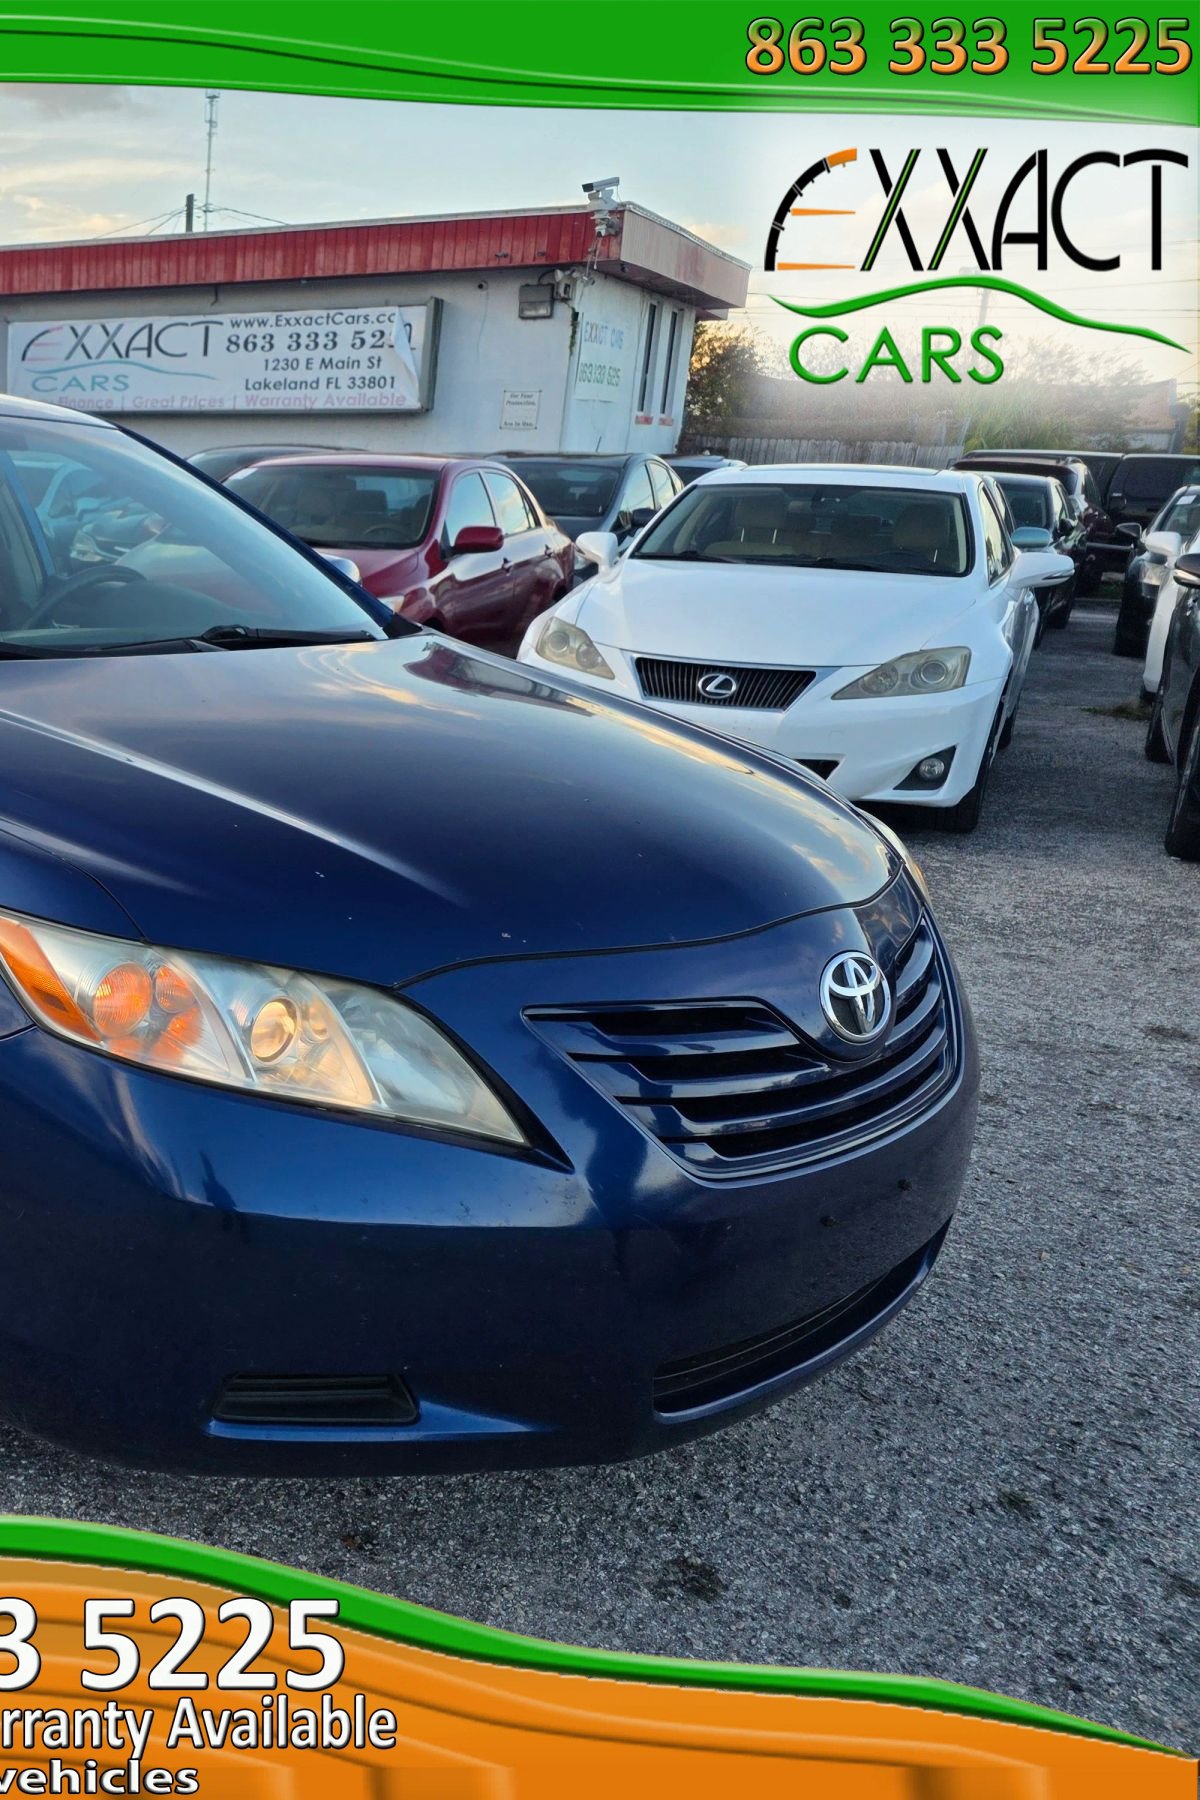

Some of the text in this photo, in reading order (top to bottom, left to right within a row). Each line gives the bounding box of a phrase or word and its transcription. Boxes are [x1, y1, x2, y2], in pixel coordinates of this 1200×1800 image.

[230, 312, 397, 329] www.ExxactCars.co
[21, 321, 224, 361] EXXACT
[226, 329, 396, 353] 863 333 52
[263, 356, 382, 371] 1230 E Main St
[31, 374, 130, 393] CARS
[245, 376, 396, 391] Lakeland FL 33801
[58, 391, 407, 410] Finance Great Prices Warranty Available
